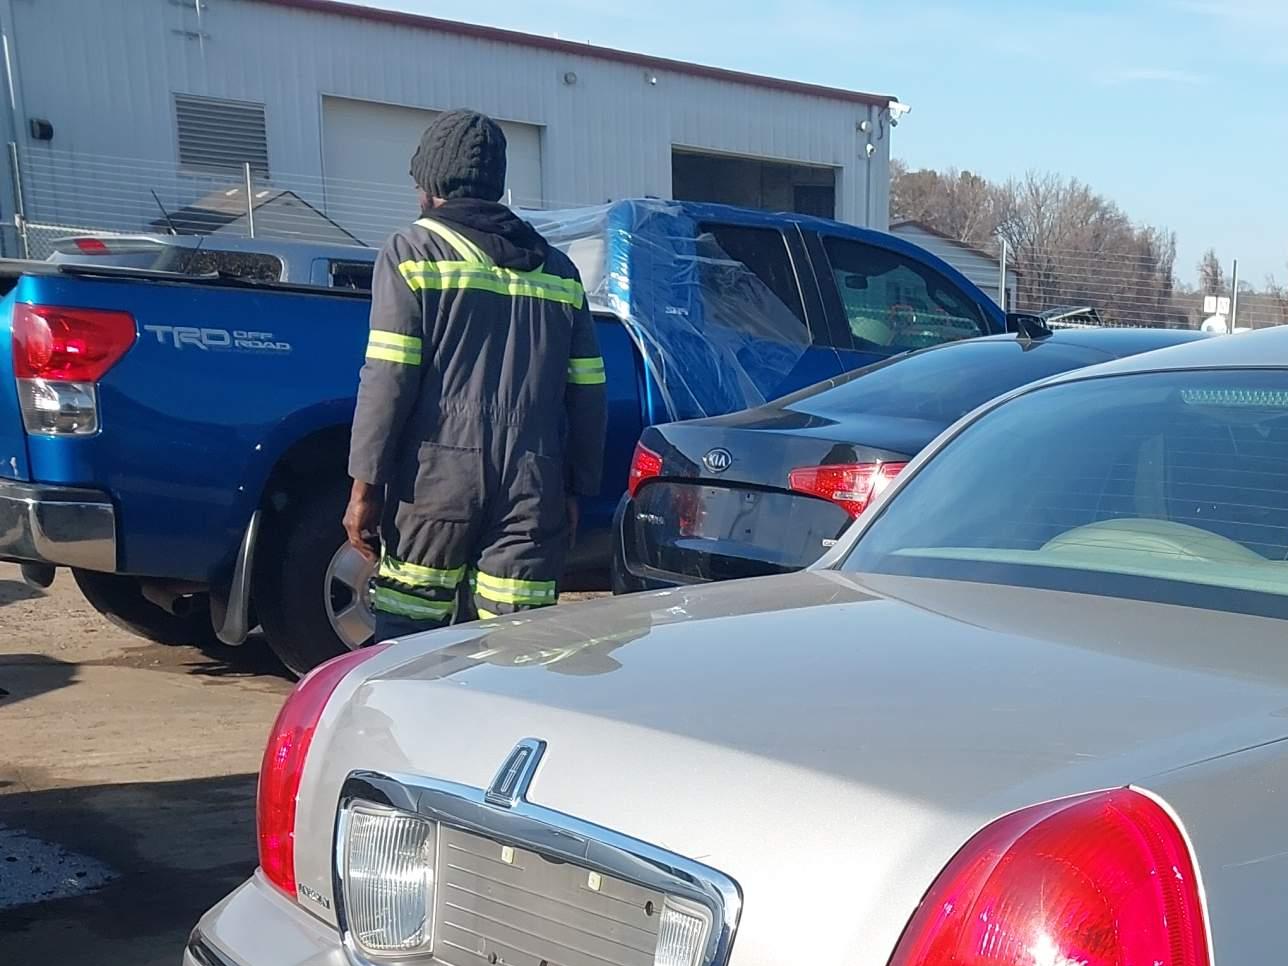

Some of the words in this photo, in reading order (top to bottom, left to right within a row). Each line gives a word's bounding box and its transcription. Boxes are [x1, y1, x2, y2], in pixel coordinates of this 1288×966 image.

[143, 324, 231, 350] TRD
[233, 330, 273, 340] OFF
[234, 339, 292, 350] ROAD
[708, 453, 727, 467] KIA
